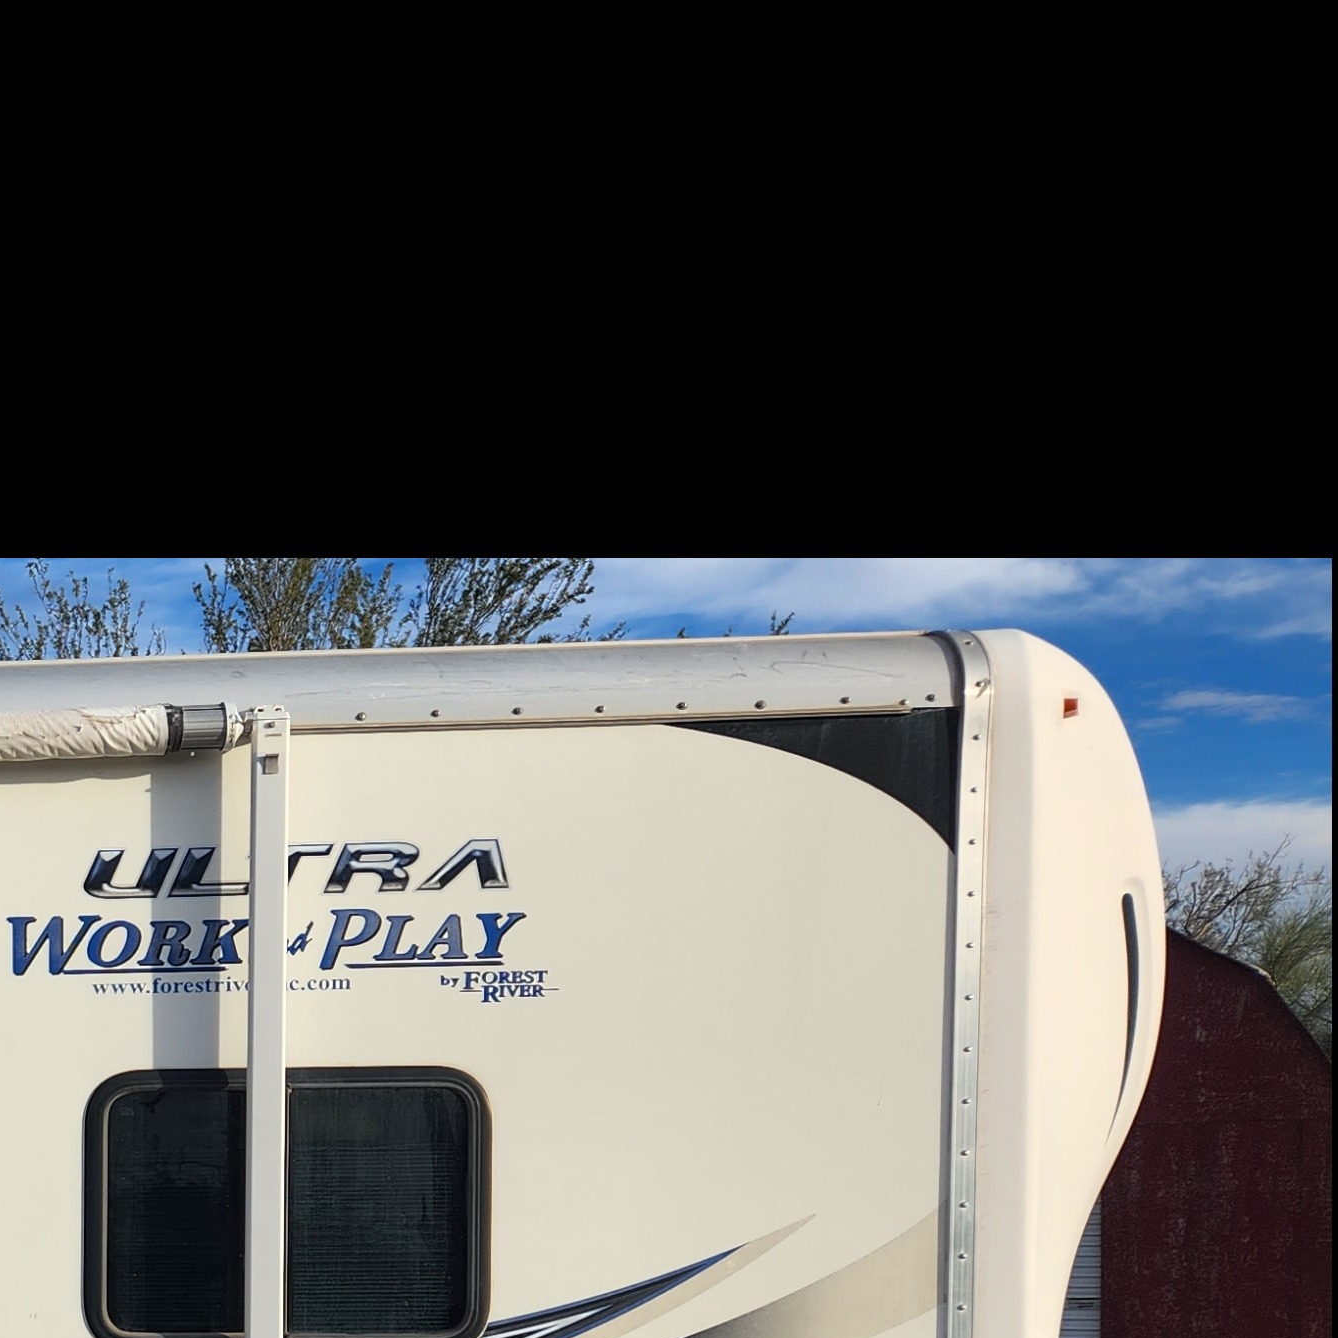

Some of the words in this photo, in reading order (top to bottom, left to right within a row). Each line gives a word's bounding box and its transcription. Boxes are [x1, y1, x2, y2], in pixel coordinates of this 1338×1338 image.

[6, 915, 249, 976] WORK
[319, 908, 527, 971] PLAY
[92, 976, 351, 995] www.forestrivc.com
[440, 975, 460, 988] by
[463, 970, 548, 989] FOREST
[480, 984, 545, 1002] RIVER
